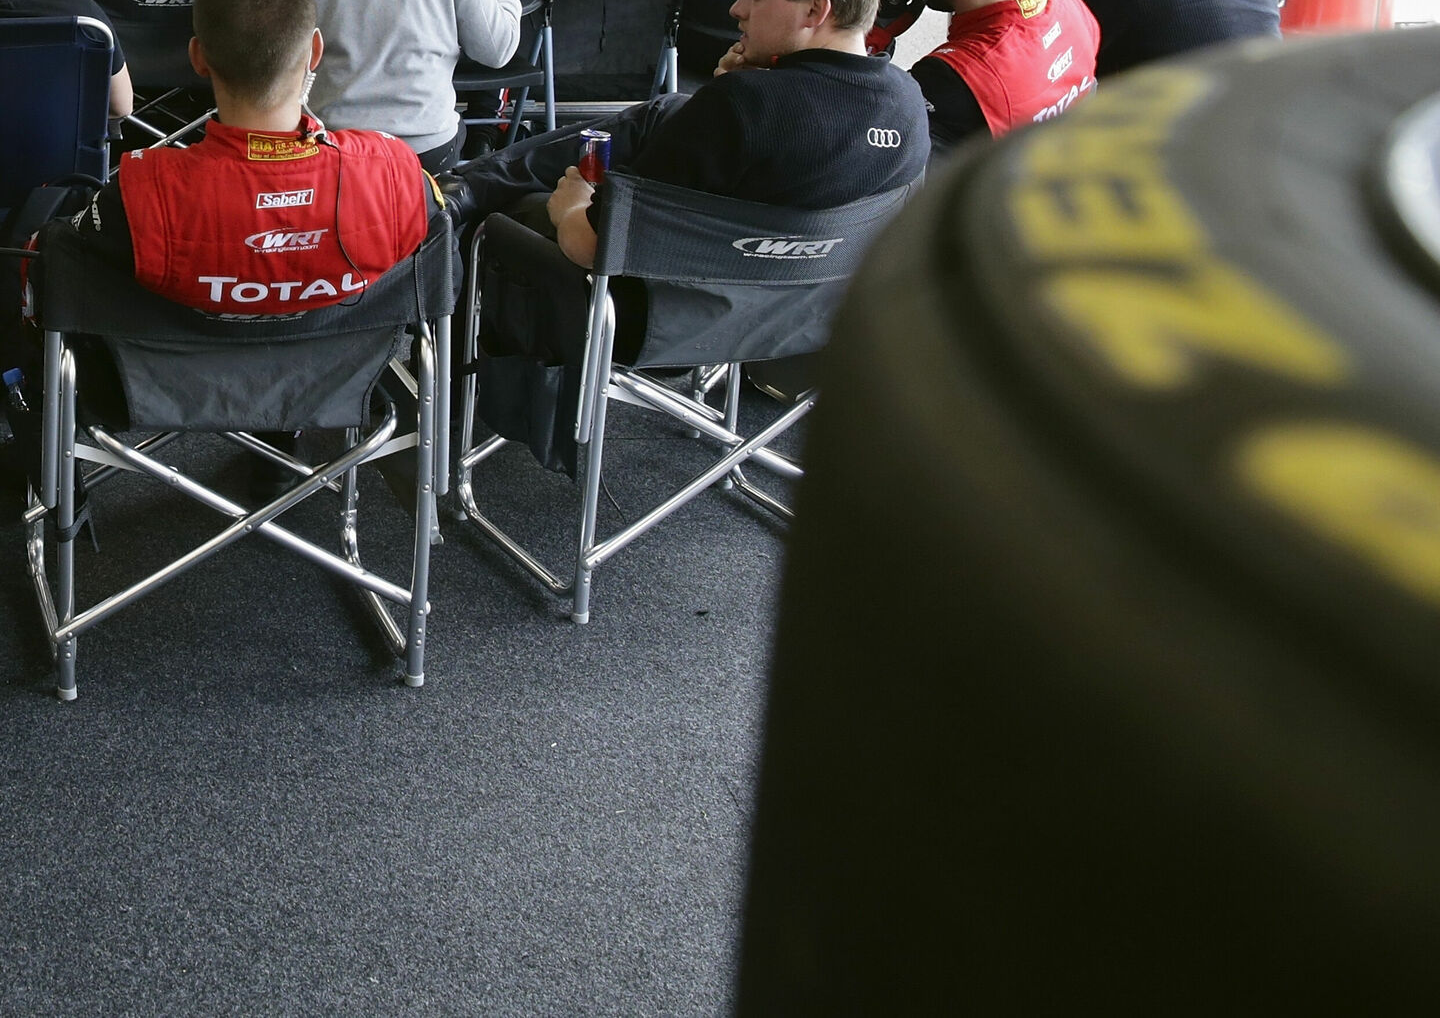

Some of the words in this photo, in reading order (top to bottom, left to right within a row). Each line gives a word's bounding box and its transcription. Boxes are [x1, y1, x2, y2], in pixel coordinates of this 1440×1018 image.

[262, 192, 309, 207] Sabelt
[262, 228, 329, 249] WRT
[754, 238, 844, 255] WRT
[198, 272, 368, 303] TOTAL
